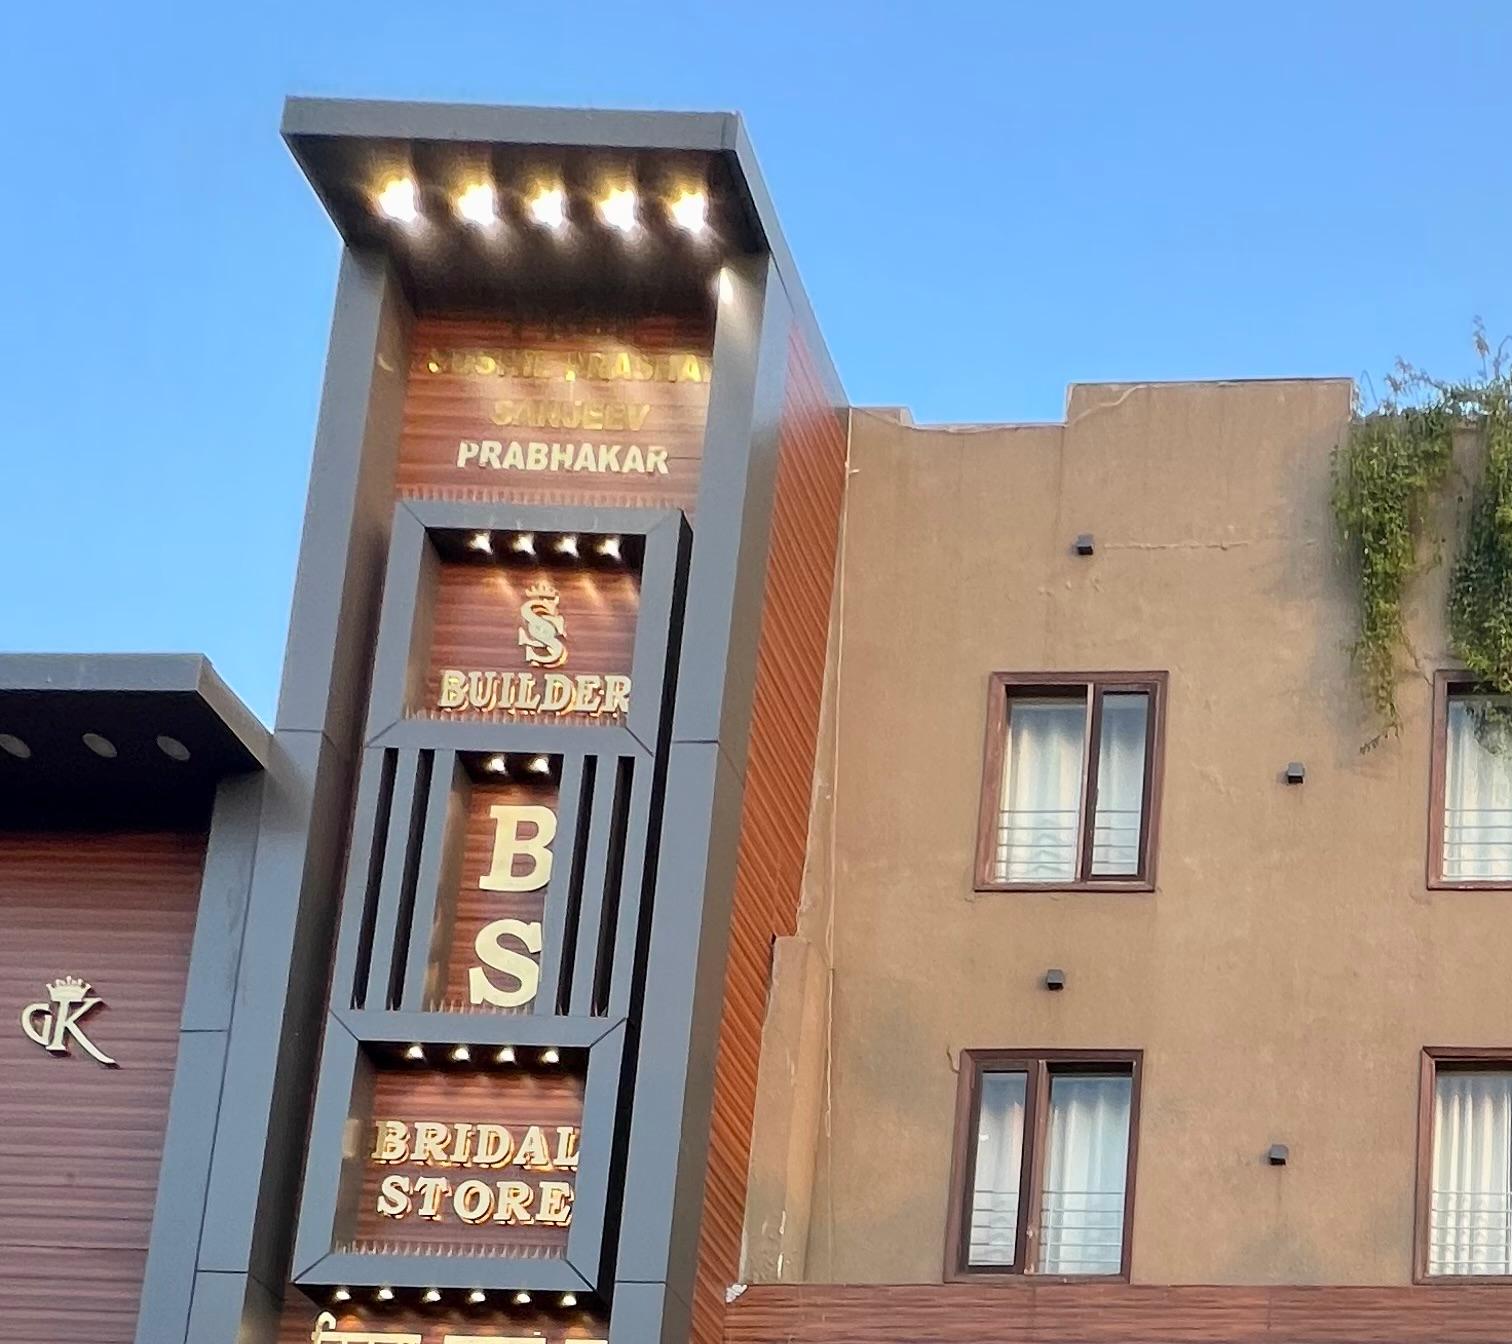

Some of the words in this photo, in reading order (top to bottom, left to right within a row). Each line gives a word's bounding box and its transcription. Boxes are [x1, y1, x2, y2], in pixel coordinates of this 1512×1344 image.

[456, 440, 670, 475] PRABHAKAR
[437, 669, 633, 715] BUILDER
[370, 1119, 581, 1170] BRIDAL
[376, 1175, 575, 1228] STORE
